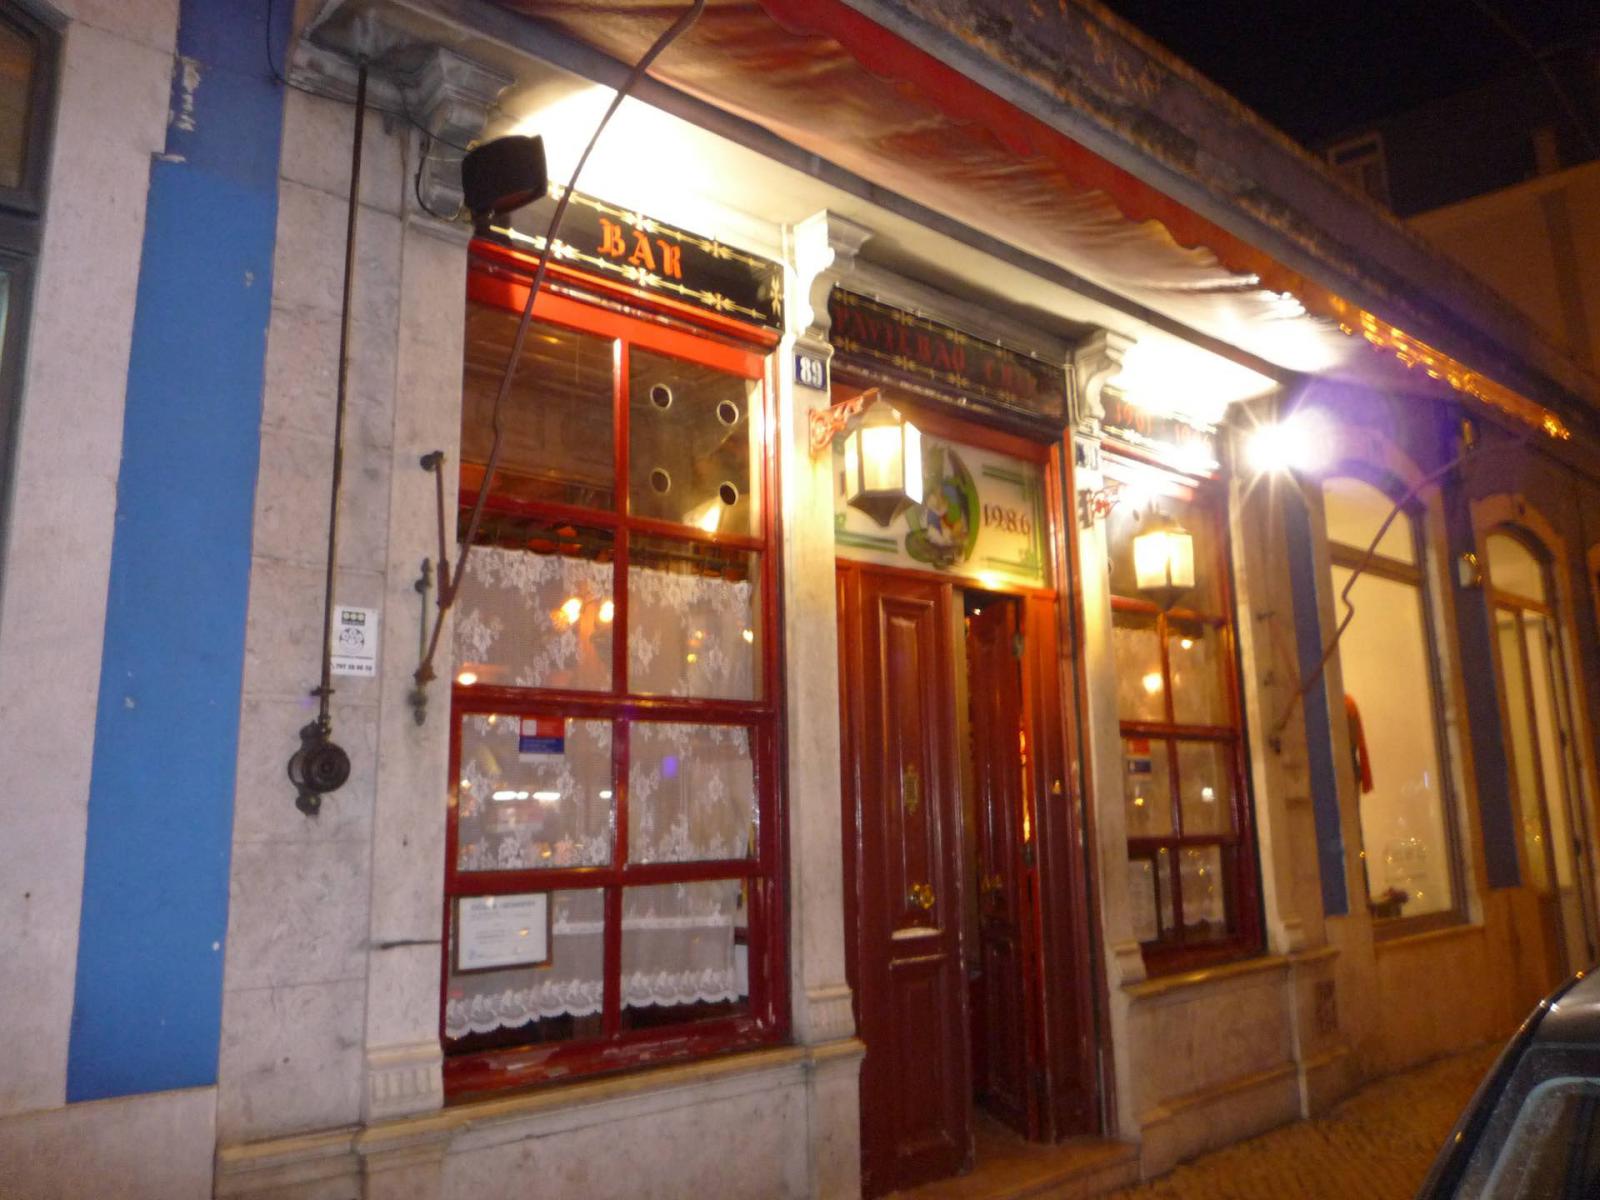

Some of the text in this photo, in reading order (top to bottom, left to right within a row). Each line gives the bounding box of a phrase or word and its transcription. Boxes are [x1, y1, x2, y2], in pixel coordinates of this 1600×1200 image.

[597, 217, 683, 279] BAR
[800, 356, 822, 388] 89
[983, 503, 1031, 535] 1986
